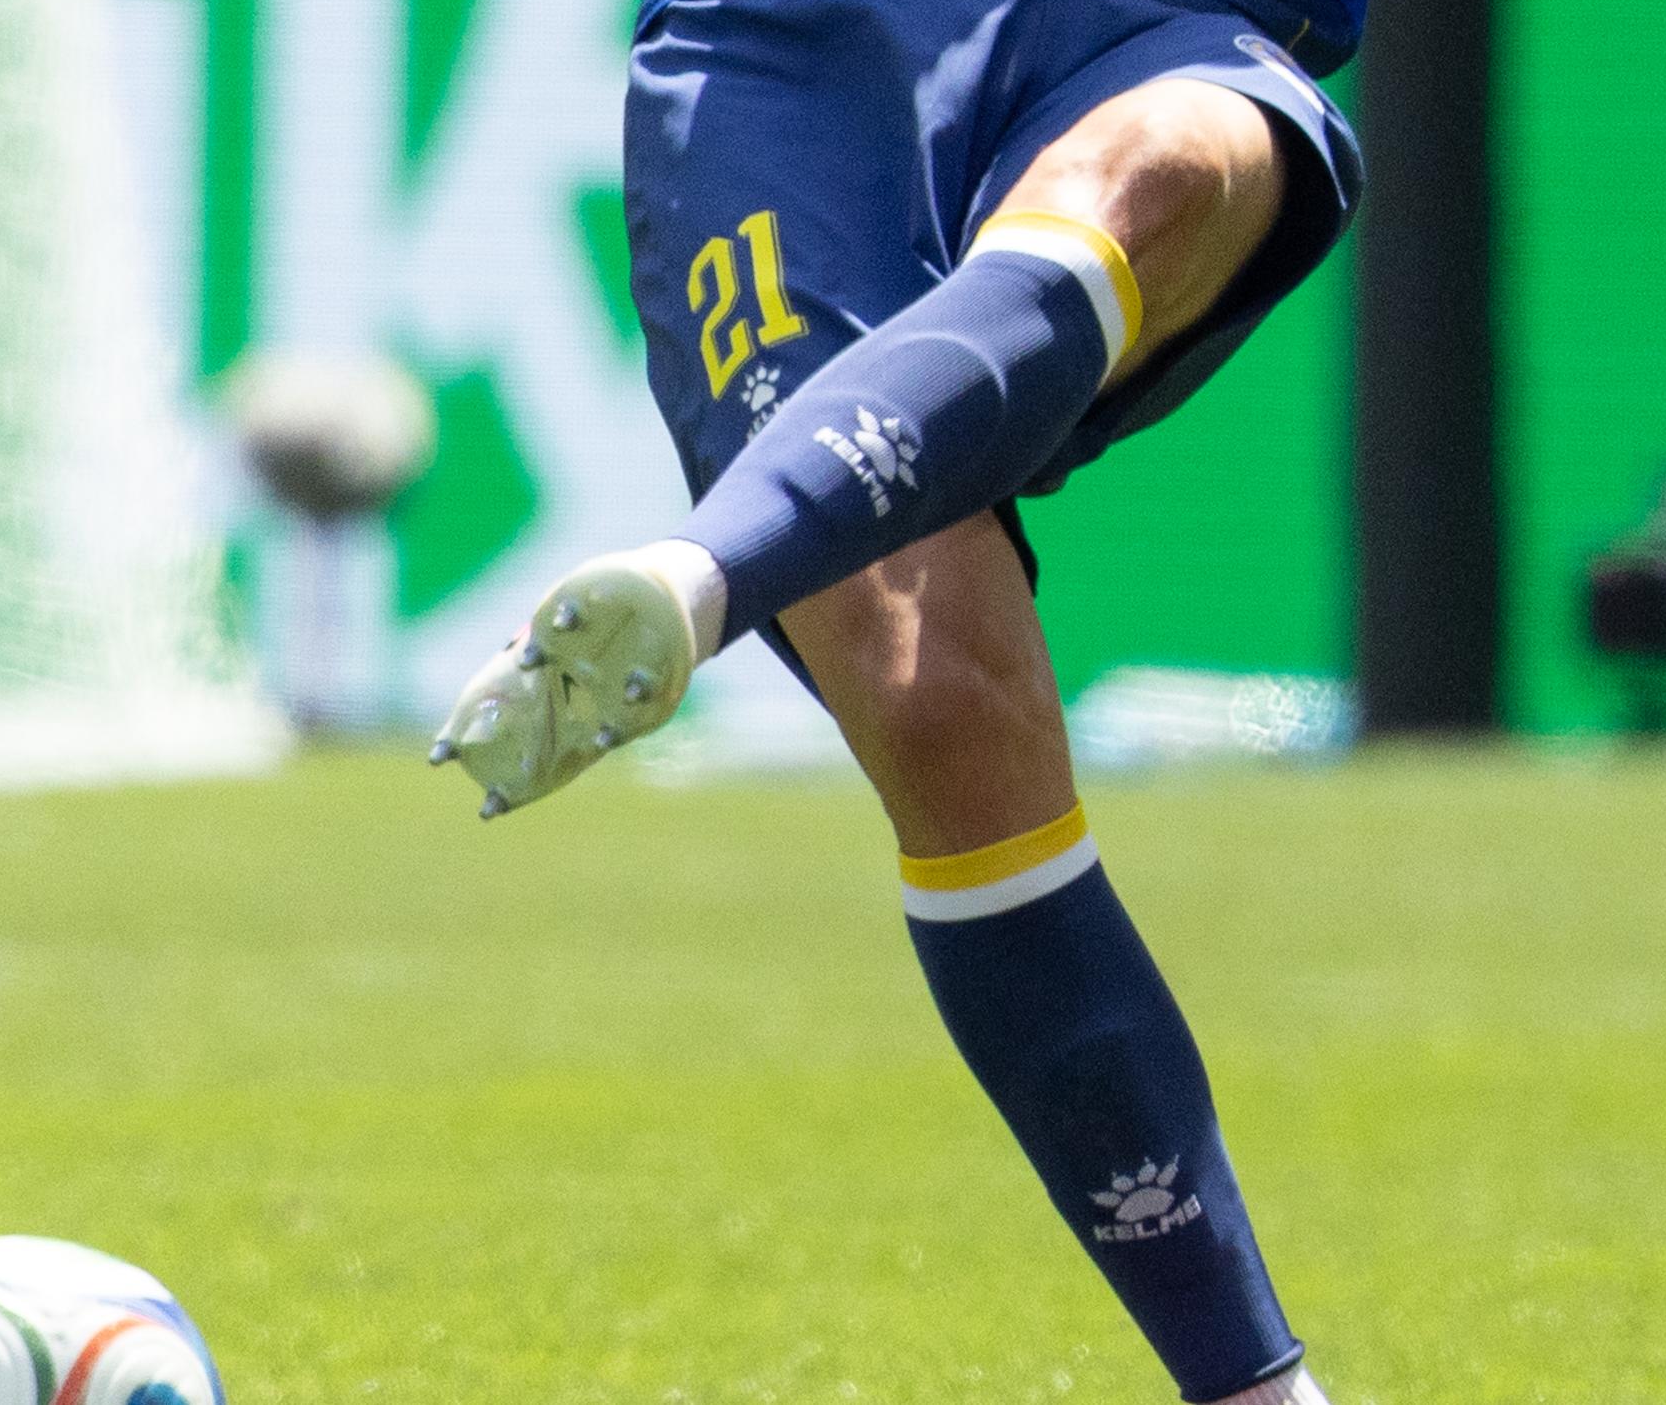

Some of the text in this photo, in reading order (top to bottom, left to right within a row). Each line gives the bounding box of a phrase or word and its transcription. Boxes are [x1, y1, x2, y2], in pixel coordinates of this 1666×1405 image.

[687, 209, 809, 401] 21
[814, 426, 892, 518] KELME
[1093, 1193, 1202, 1242] KELME
